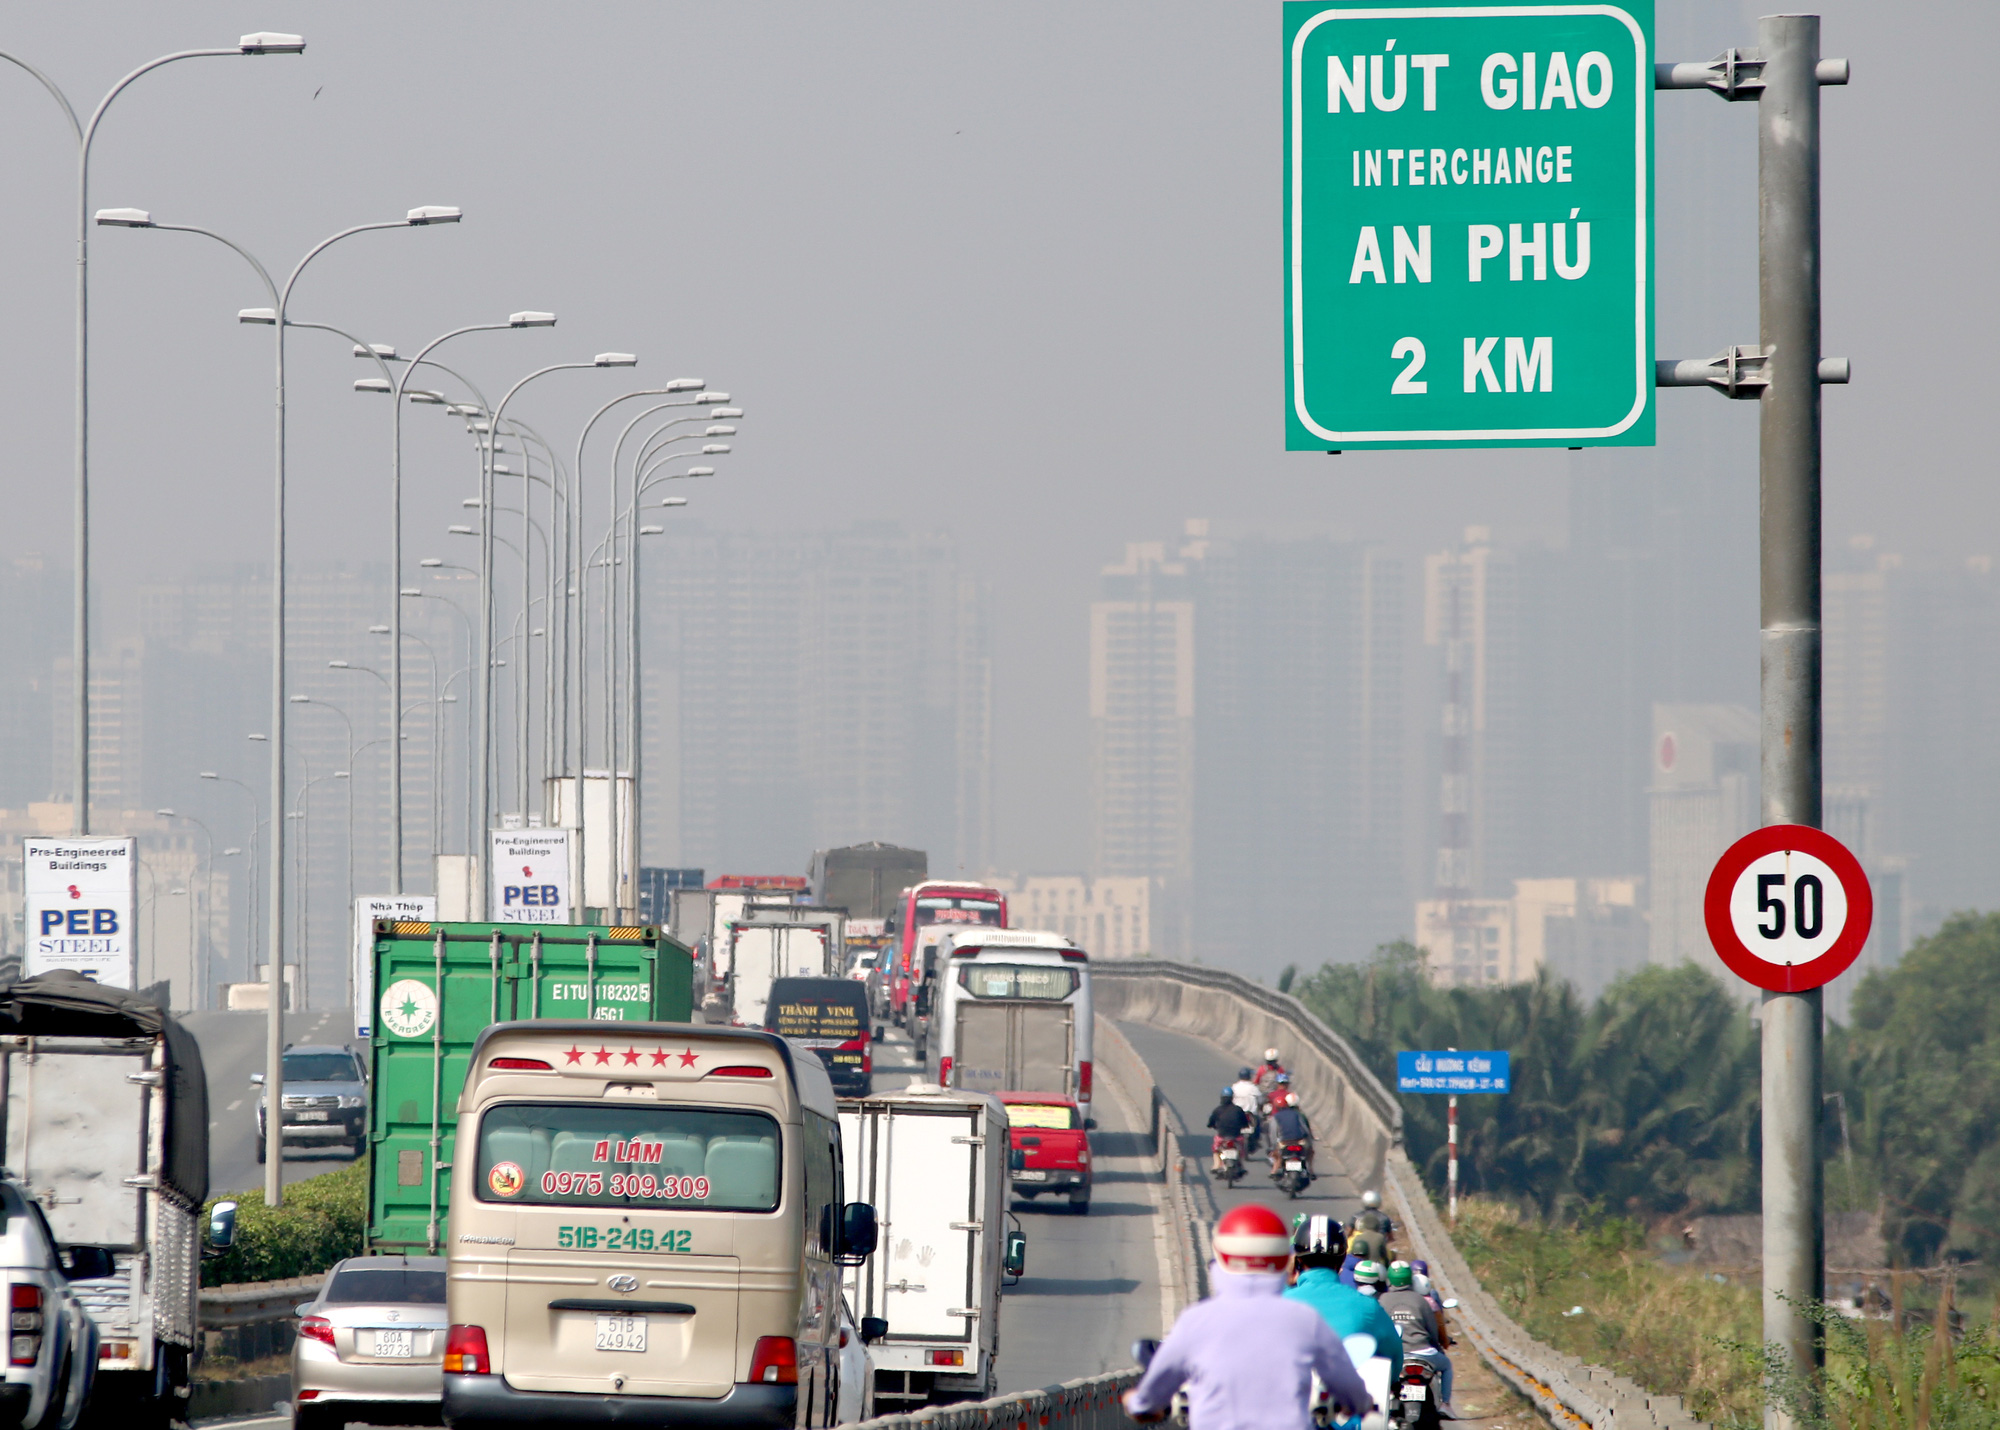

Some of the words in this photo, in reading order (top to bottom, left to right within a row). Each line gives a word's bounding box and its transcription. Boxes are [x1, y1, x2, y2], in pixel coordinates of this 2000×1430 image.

[1326, 39, 1450, 113] NÚT
[1480, 51, 1613, 111] GIAO
[1353, 145, 1573, 187] INTERCHANGE
[1348, 224, 1432, 284] AN
[1468, 207, 1592, 282] PHÚ
[1391, 336, 1427, 395] 2
[1463, 336, 1553, 393] KM
[495, 837, 564, 846] Pre-Engineered
[30, 847, 126, 858] Pre-Engineered
[509, 848, 551, 856] Buildings
[49, 861, 107, 872] Buildings
[504, 884, 560, 906] PEB
[503, 908, 560, 921] STEEL
[1757, 874, 1823, 939] 50
[40, 909, 119, 936] PEB
[39, 939, 120, 953] STEEL
[553, 984, 587, 1000] EITU
[779, 1002, 818, 1016] THÀNH
[385, 1010, 432, 1034] EVERGREEN
[592, 1140, 609, 1162] A
[614, 1136, 663, 1163] LÂM
[541, 1171, 602, 1196] 0975
[609, 1173, 710, 1199] 309.309
[558, 1226, 692, 1252] 51B-249.42
[608, 1317, 634, 1333] 51B
[383, 1332, 403, 1343] 60A
[597, 1333, 644, 1350] 249.42
